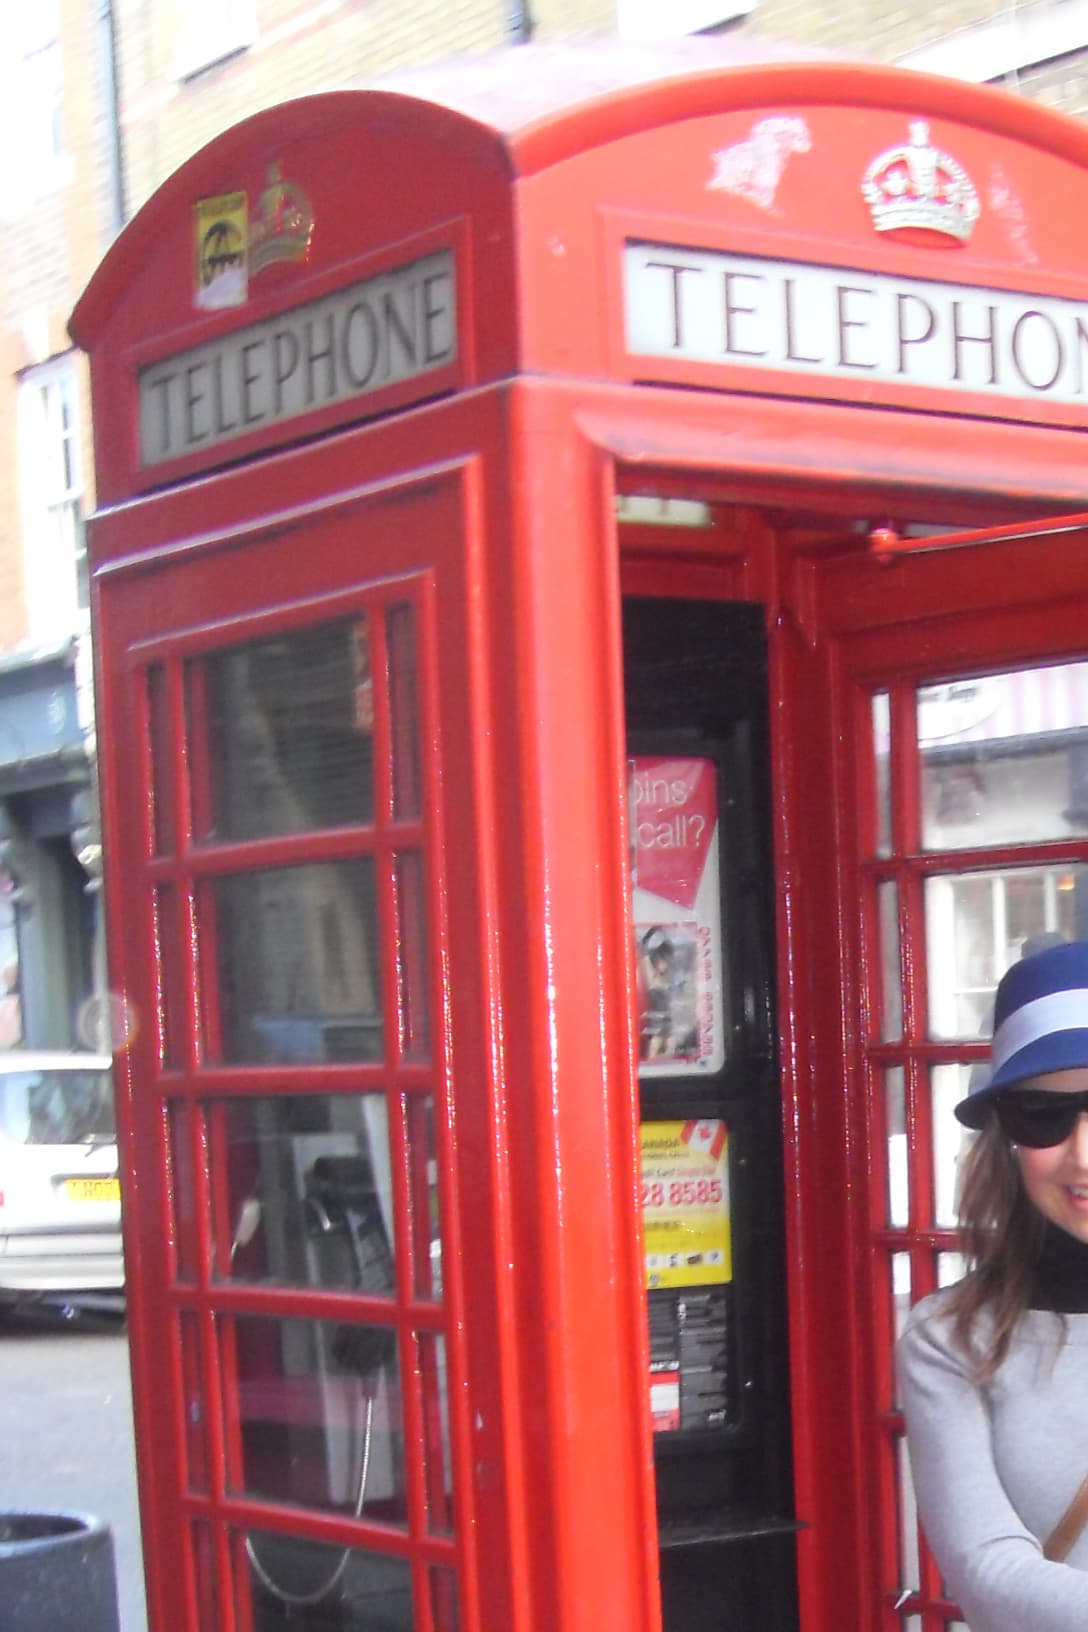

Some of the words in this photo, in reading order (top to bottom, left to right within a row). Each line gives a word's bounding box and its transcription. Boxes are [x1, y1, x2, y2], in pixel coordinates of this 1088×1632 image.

[149, 271, 451, 452] TELEPHONE
[637, 814, 706, 850] call?
[668, 1178, 723, 1206] 8585
